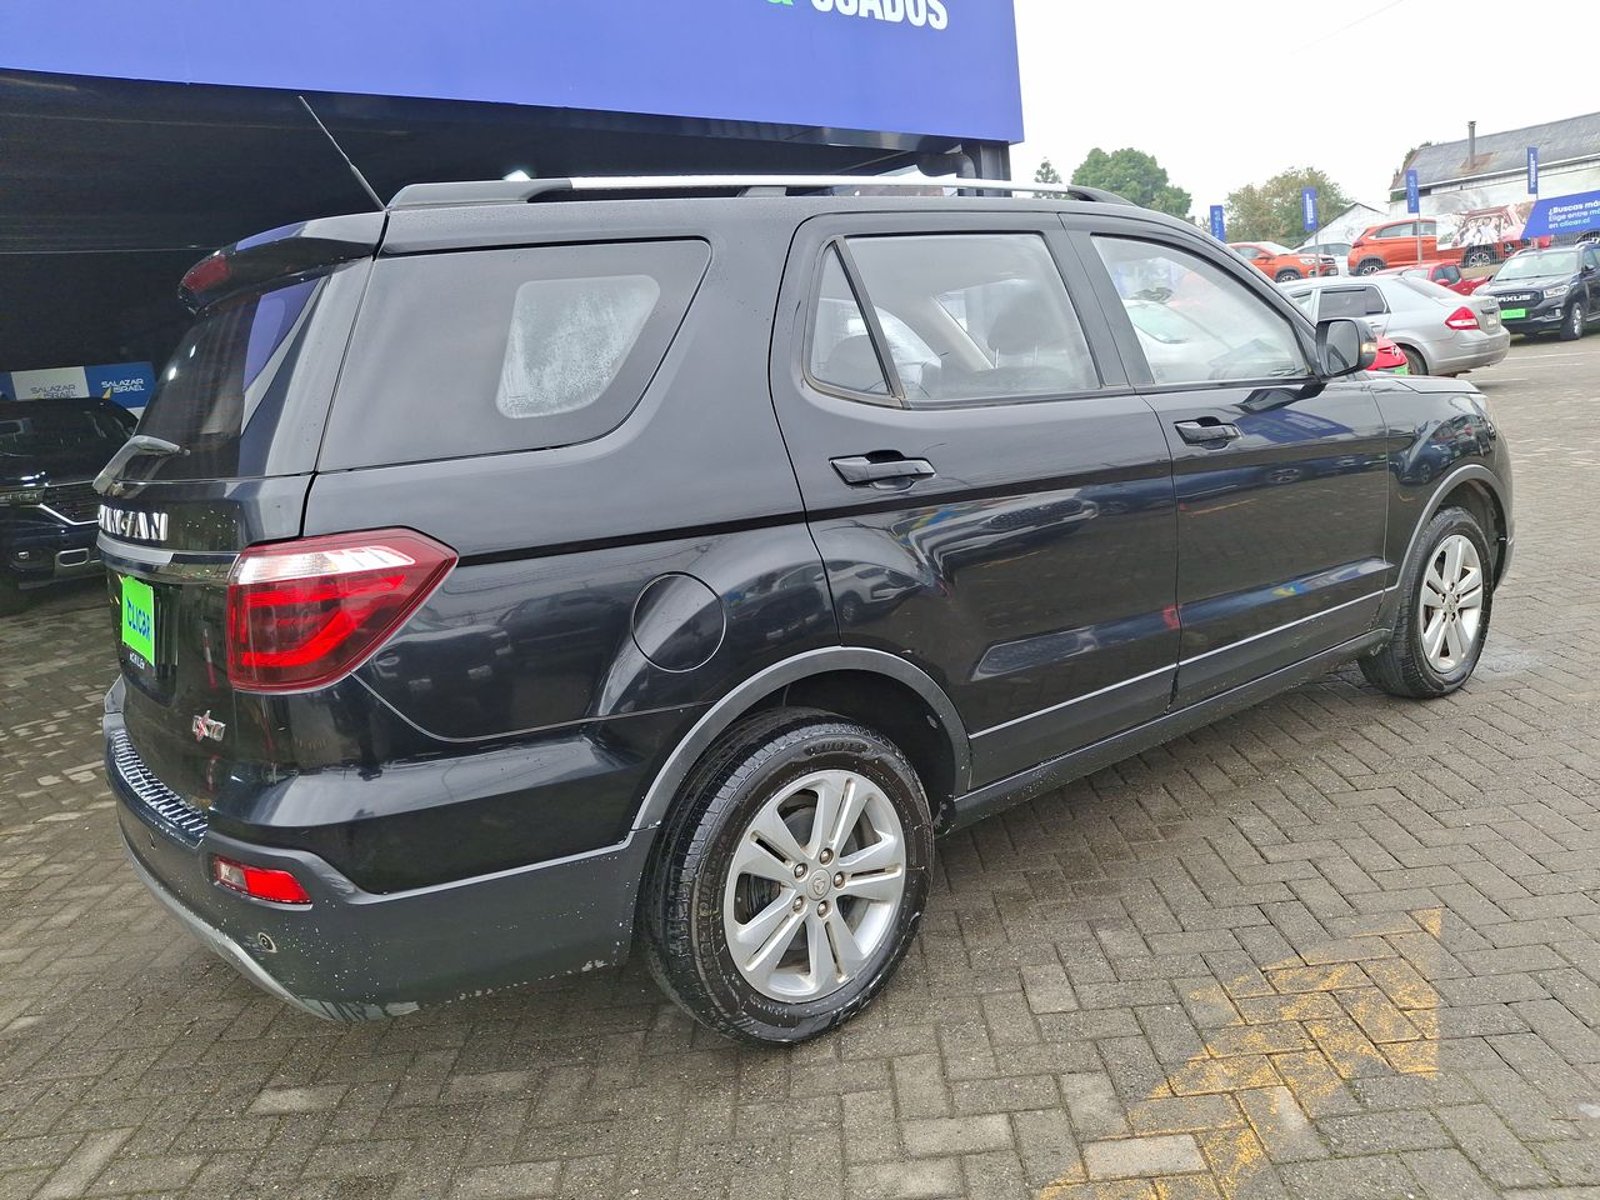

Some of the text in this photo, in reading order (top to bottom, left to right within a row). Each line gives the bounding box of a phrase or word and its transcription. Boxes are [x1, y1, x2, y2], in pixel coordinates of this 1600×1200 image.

[1498, 294, 1531, 302] AXUS
[101, 378, 144, 388] SALAZAR
[30, 384, 76, 394] SALAZAR
[113, 384, 145, 393] ISRAEL
